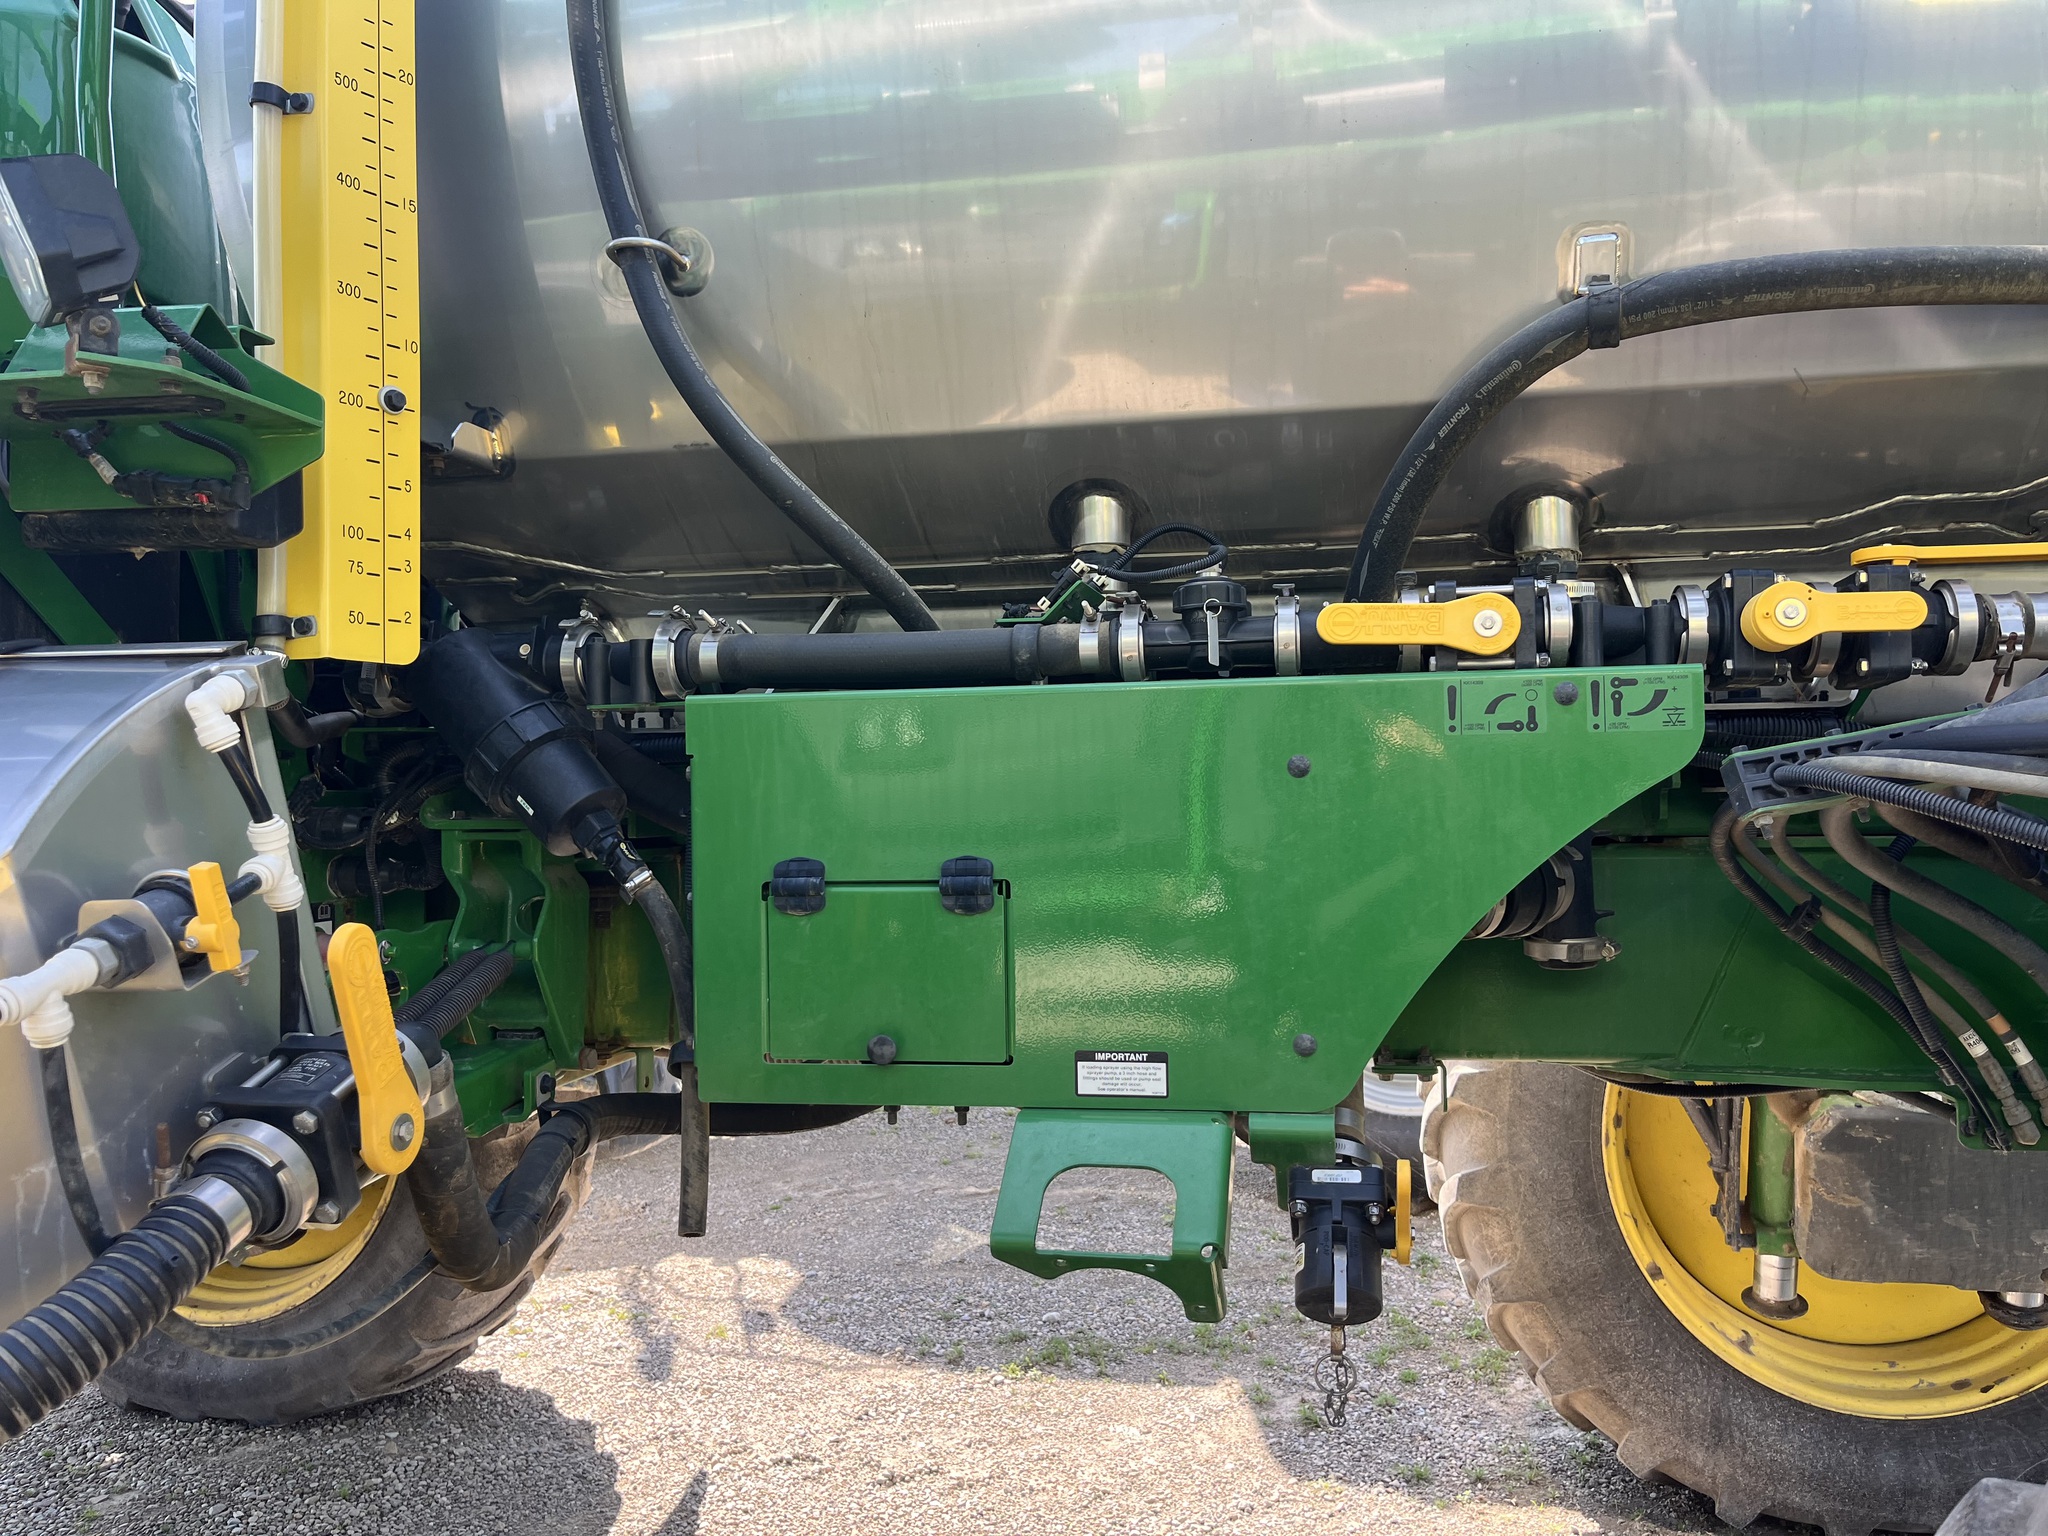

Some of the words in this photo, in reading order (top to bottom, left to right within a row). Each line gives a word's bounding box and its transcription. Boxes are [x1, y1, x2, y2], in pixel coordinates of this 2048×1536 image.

[334, 72, 358, 92] 500
[398, 68, 414, 86] 20
[336, 172, 361, 191] 400
[402, 198, 416, 214] 15
[336, 280, 362, 299] 300
[1644, 311, 1656, 320] 200
[404, 339, 418, 354] 10
[1480, 360, 1522, 397] Continental
[339, 390, 364, 408] 200
[1437, 403, 1471, 438] FRONTIER
[404, 480, 412, 493] 5
[770, 455, 802, 488] Continental
[812, 496, 840, 522] FRONTIER
[1393, 492, 1402, 502] 200
[1388, 501, 1397, 514] PSI
[342, 524, 364, 540] 100
[404, 528, 412, 540] 4
[348, 560, 364, 575] 75
[404, 560, 412, 573] 3
[348, 611, 364, 624] 50
[404, 612, 412, 624] 2
[1095, 1052, 1148, 1061] IMPORTANT
